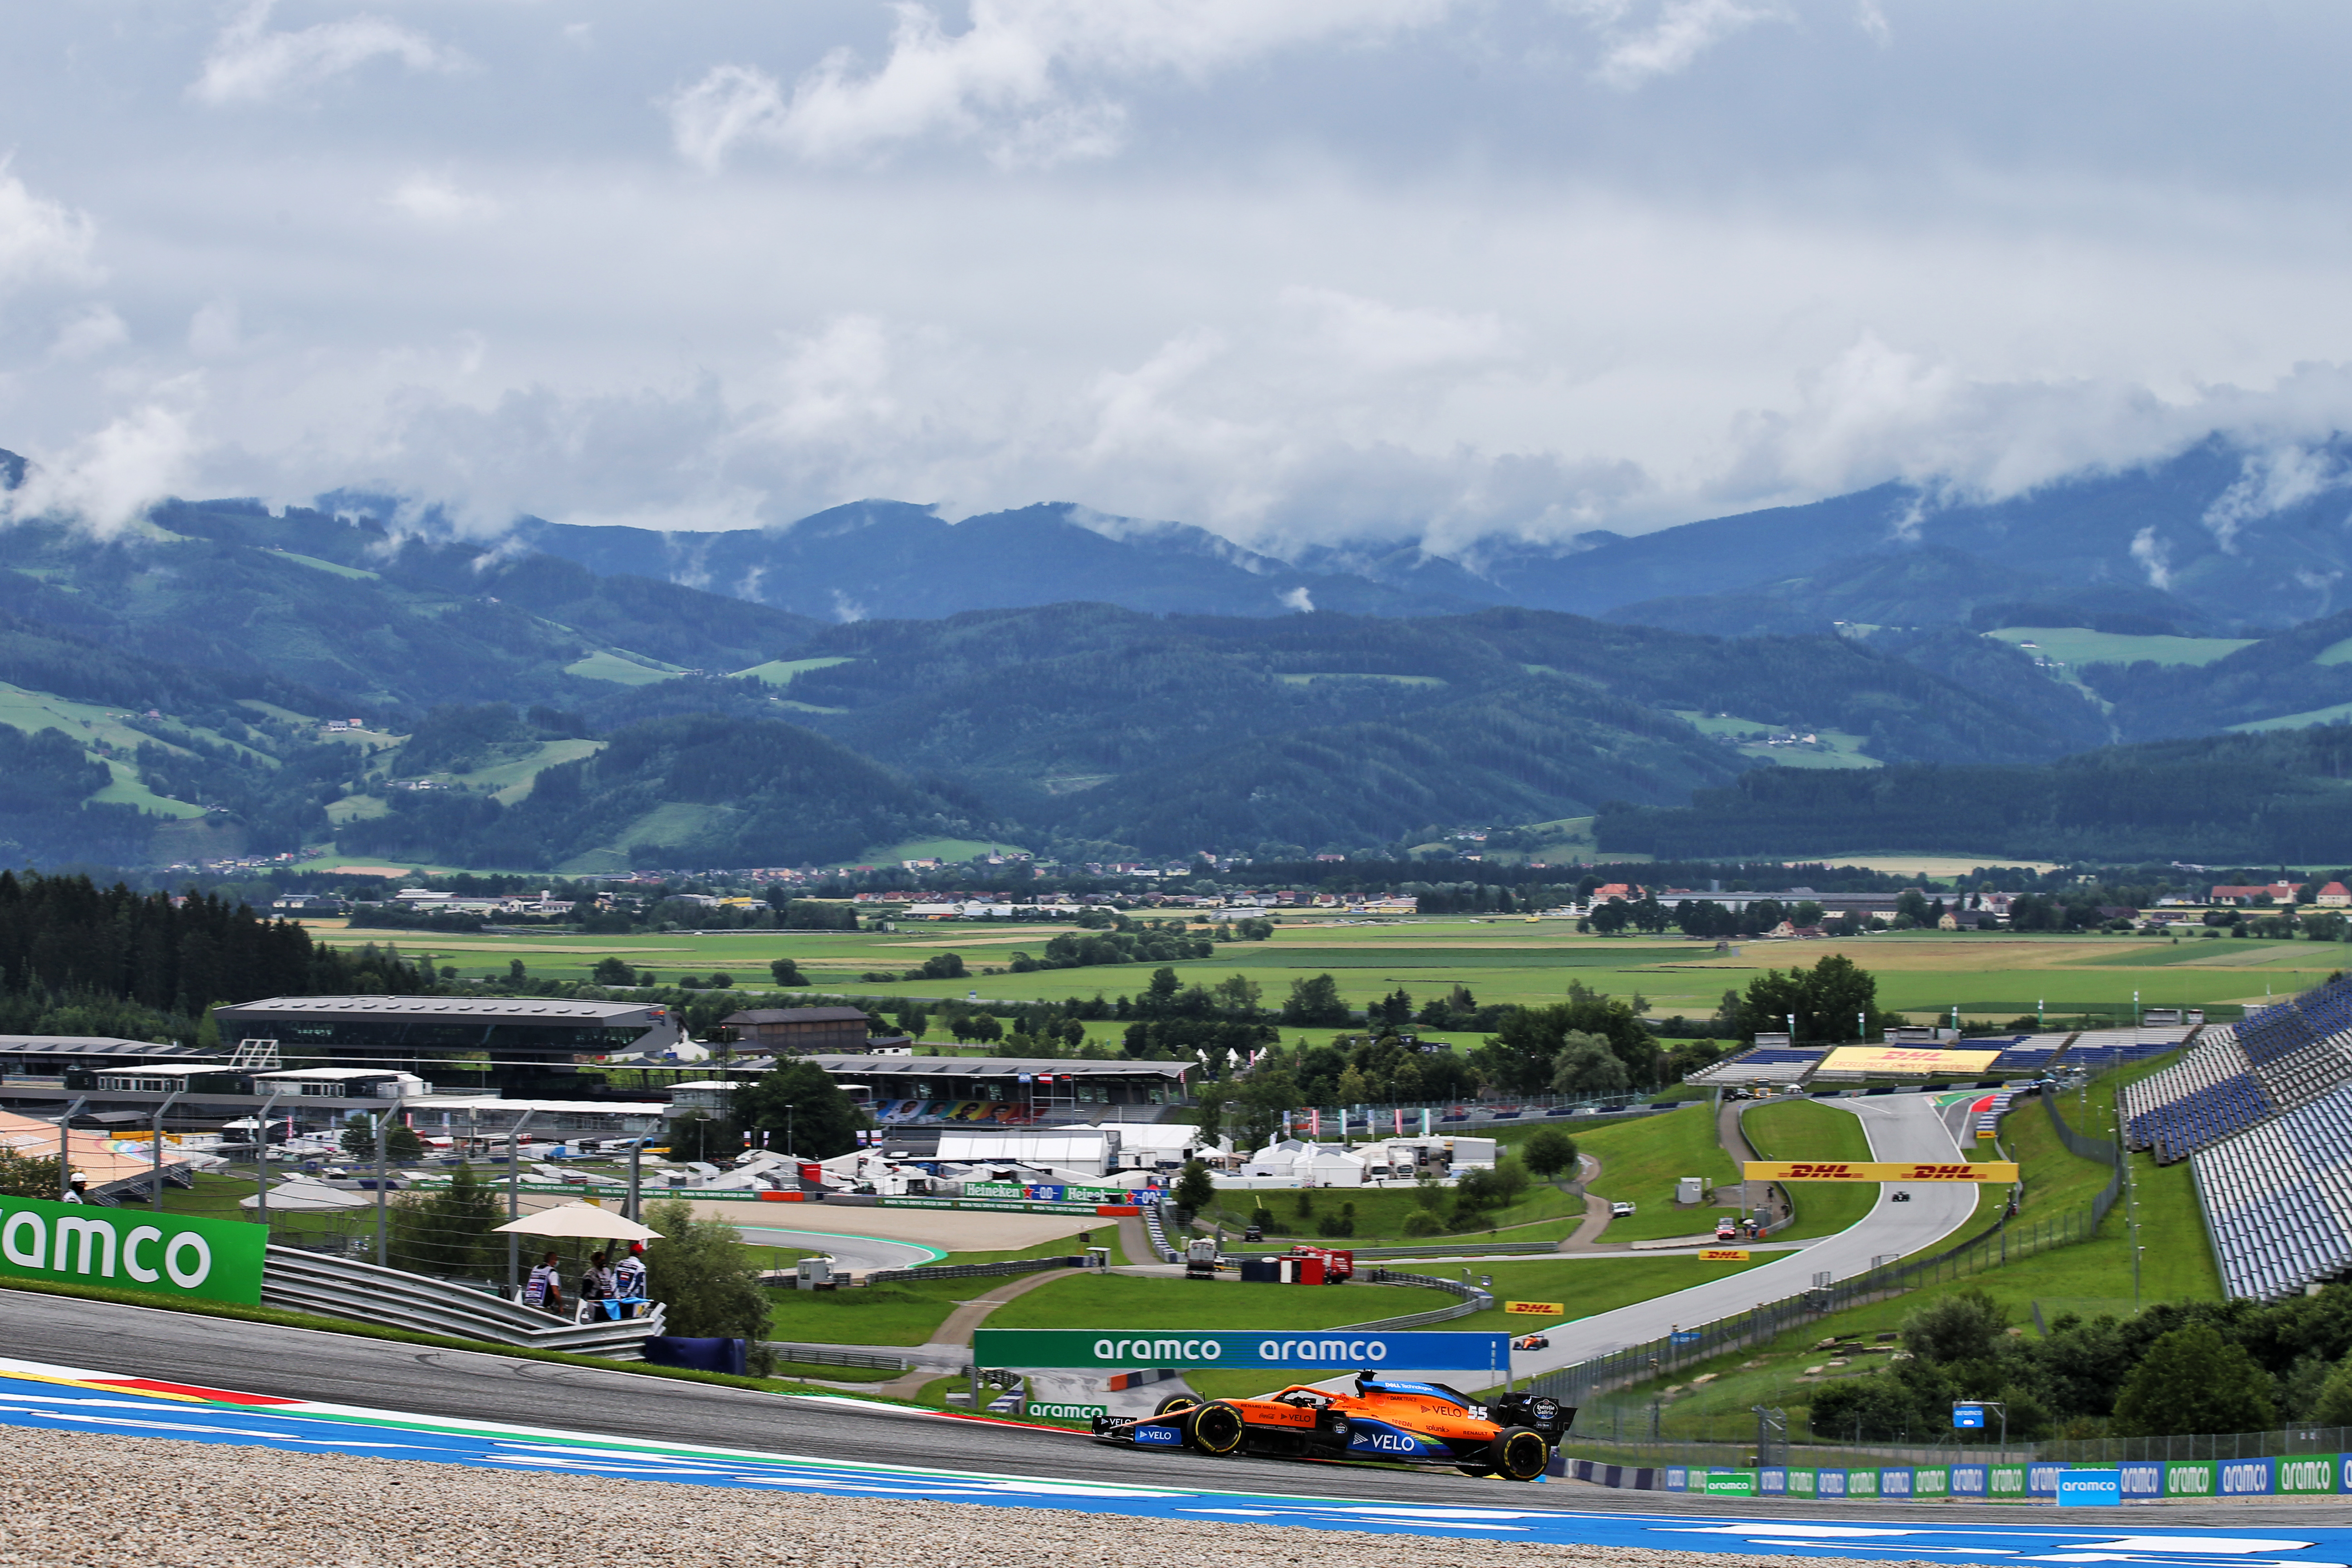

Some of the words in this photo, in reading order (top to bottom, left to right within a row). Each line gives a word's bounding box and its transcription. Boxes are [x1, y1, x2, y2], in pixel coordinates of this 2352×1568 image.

[1880, 1051, 1943, 1061] DHL
[1790, 1165, 1851, 1178] DHL
[1913, 1166, 1975, 1179] DHL
[966, 1183, 1020, 1198] Heineken
[0, 1208, 212, 1289] amco
[1515, 1303, 1553, 1313] DHL
[1093, 1339, 1221, 1360] aramco
[1259, 1340, 1387, 1361] aramco
[1401, 1383, 1433, 1392] Technologies
[1029, 1404, 1104, 1419] aramco
[1289, 1414, 1311, 1422] VELO
[1432, 1405, 1462, 1418] VELO
[1467, 1405, 1488, 1421] 55
[1148, 1431, 1171, 1440] VELO
[1372, 1434, 1415, 1451] VELO
[2169, 1466, 2209, 1493] aramco
[2223, 1464, 2267, 1492] aramco
[2281, 1461, 2331, 1490] aramco
[1709, 1482, 1749, 1490] aramco
[2062, 1481, 2117, 1491] aramco
